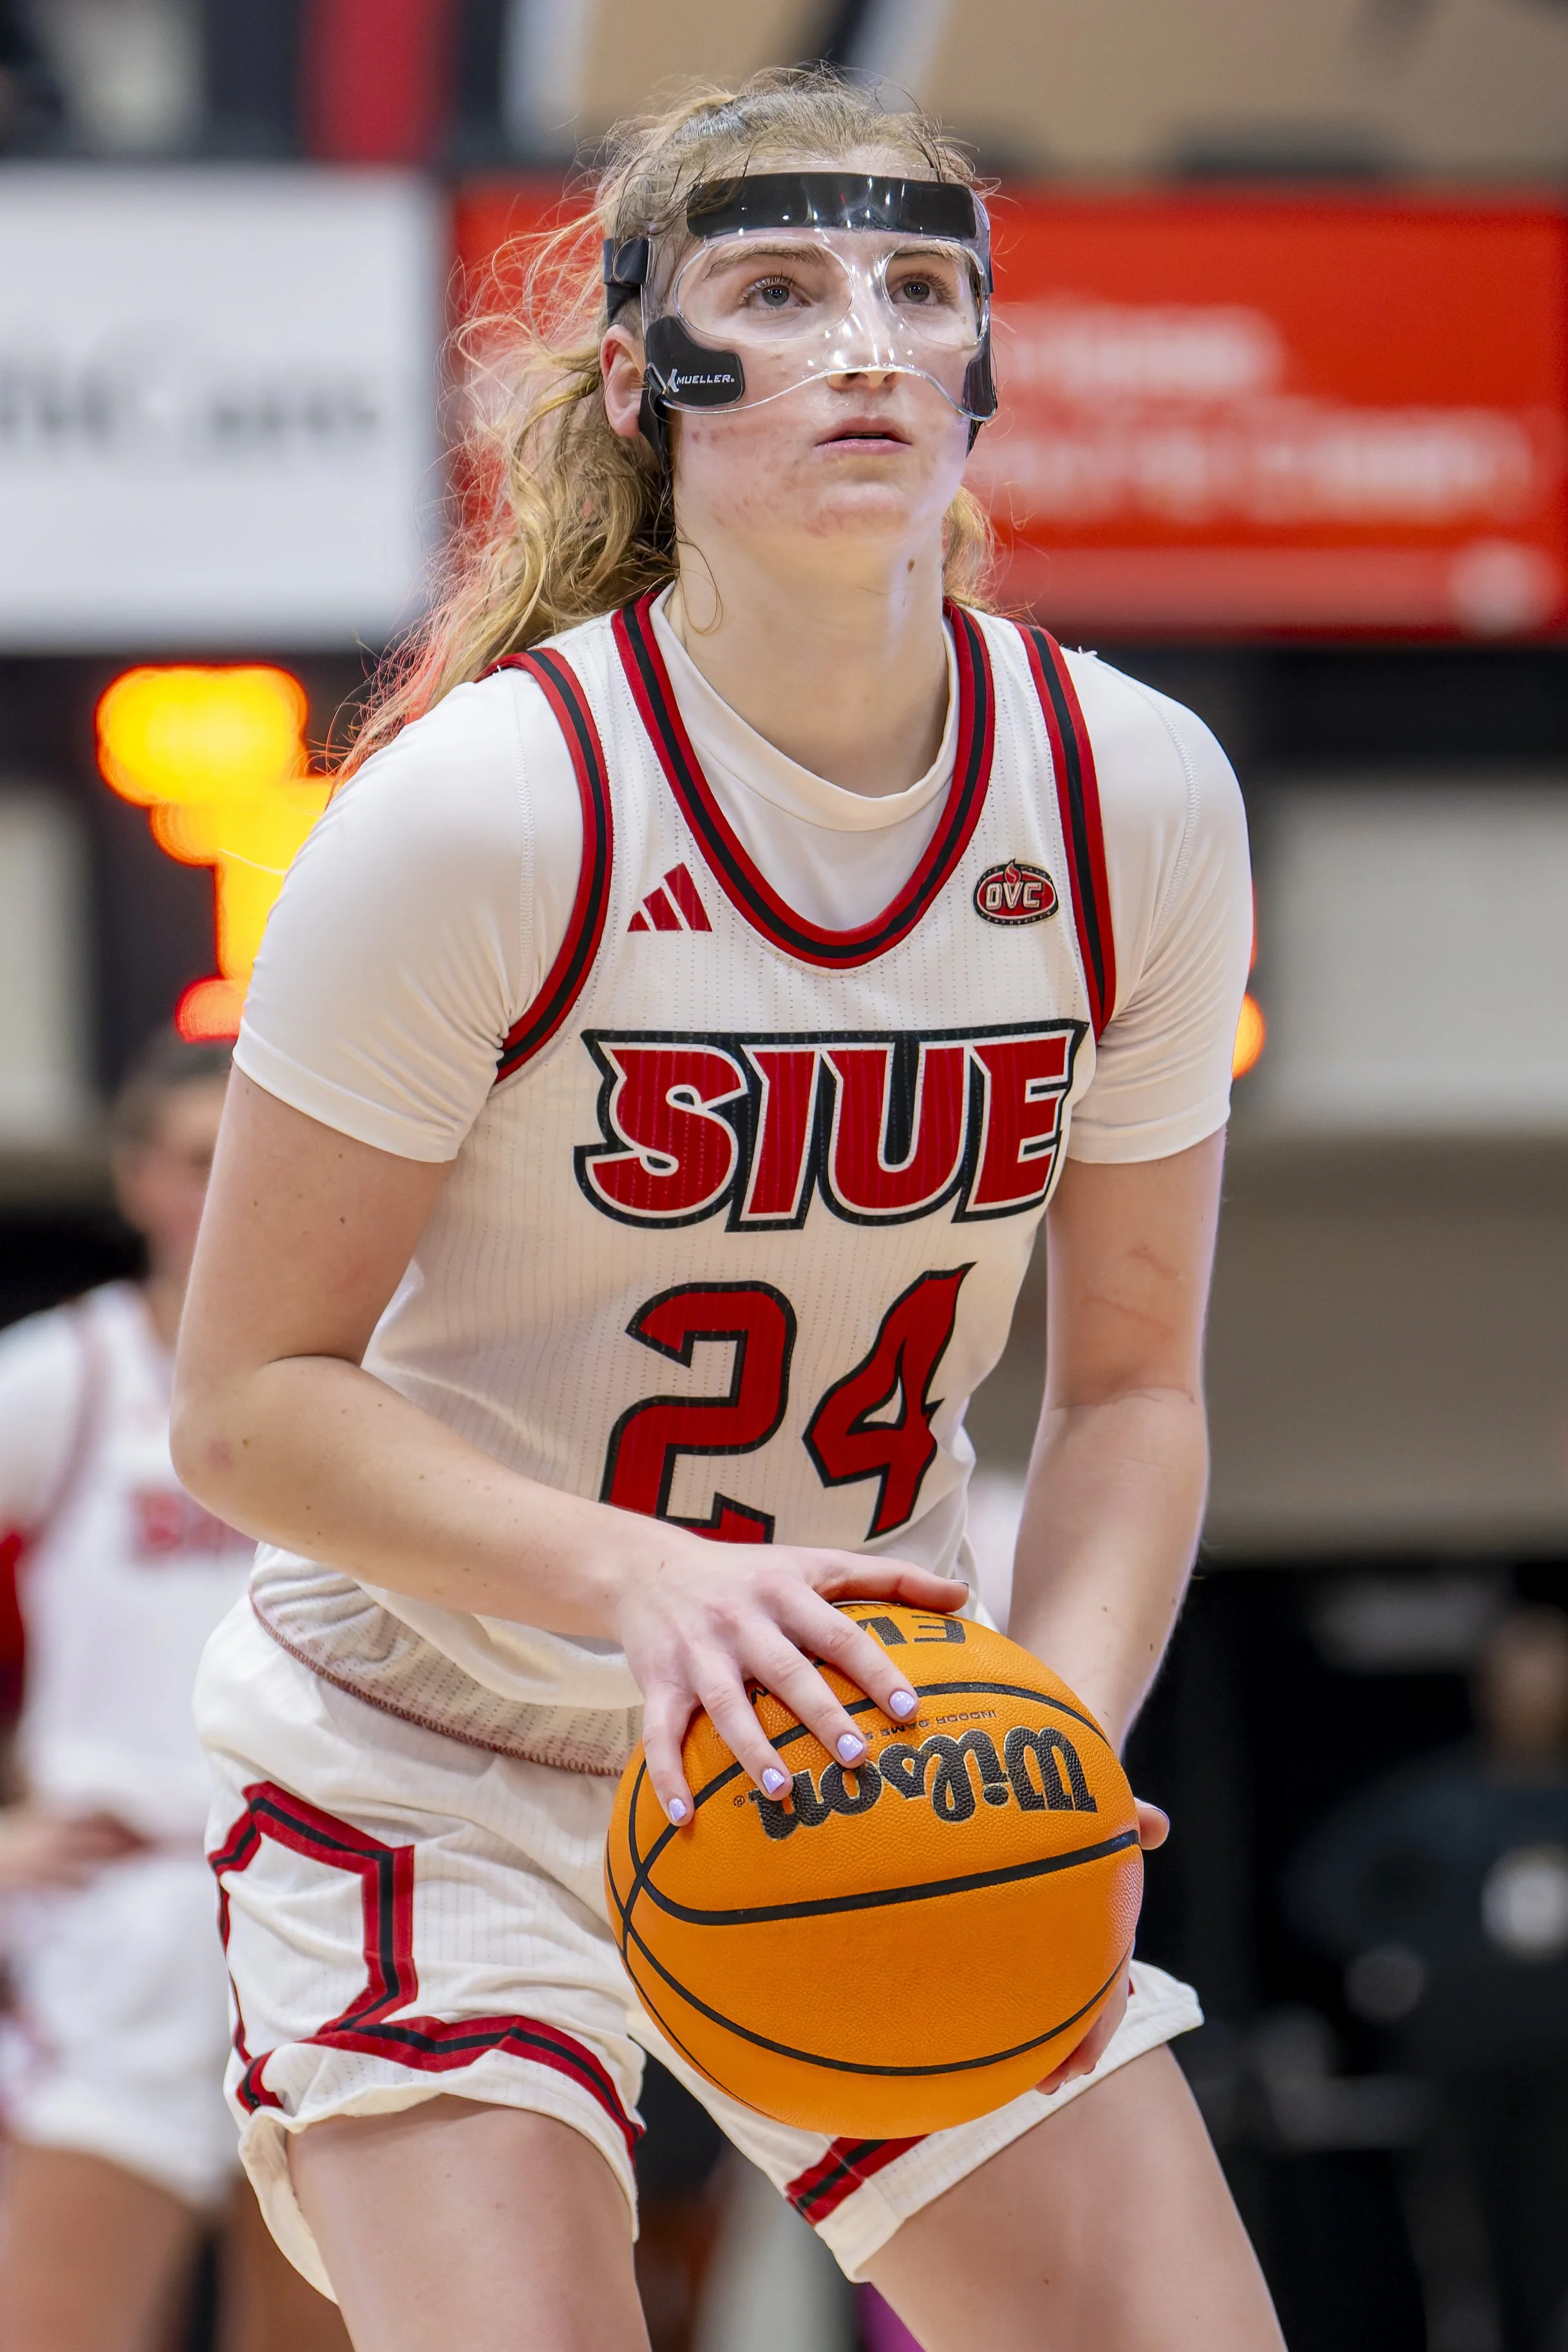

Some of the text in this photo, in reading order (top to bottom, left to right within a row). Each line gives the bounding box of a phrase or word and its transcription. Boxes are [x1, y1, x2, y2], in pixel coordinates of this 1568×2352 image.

[985, 881, 1043, 911] OVC
[573, 1018, 1090, 1233] SIUE
[600, 1261, 978, 1544] 24
[880, 1720, 930, 1737] GAME
[936, 1710, 997, 1725] INDOOR
[748, 1725, 1098, 1841] Wilson
